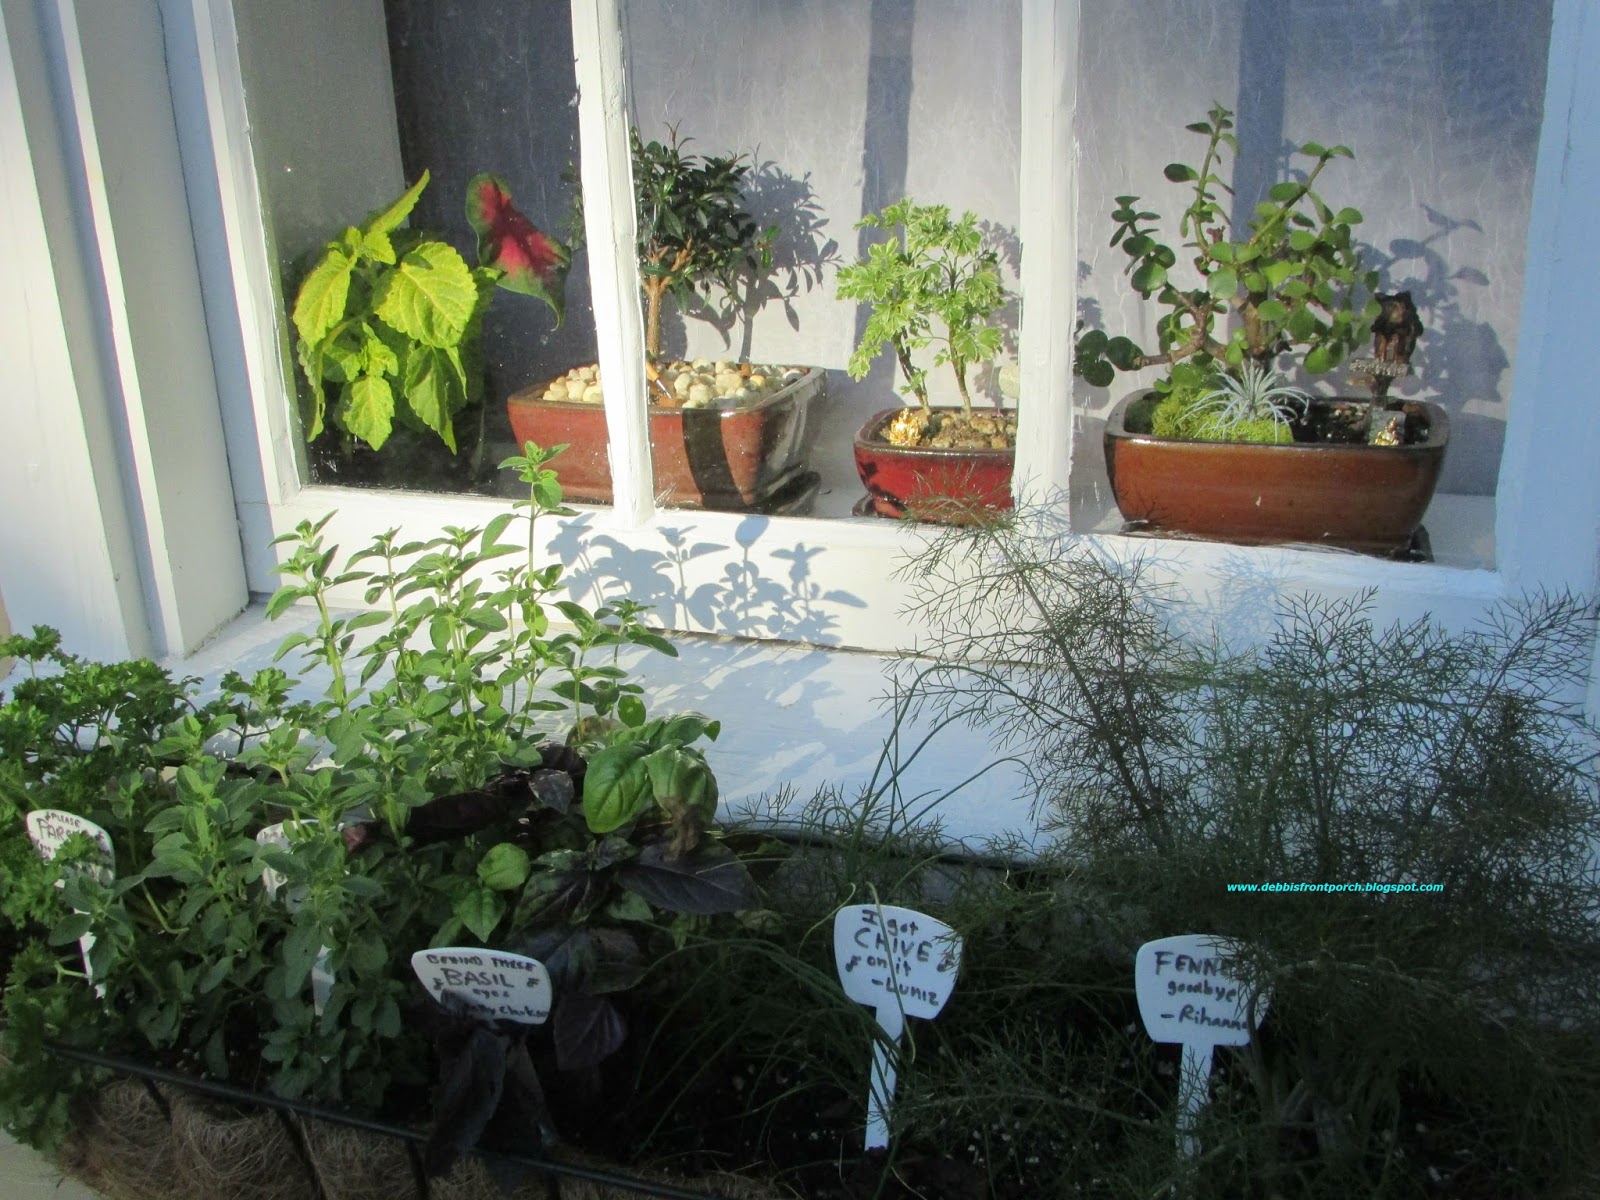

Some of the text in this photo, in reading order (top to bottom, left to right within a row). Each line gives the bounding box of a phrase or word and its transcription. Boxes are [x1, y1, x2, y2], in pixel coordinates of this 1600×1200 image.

[886, 918, 919, 937] got
[853, 926, 933, 963] CHIVE
[866, 955, 912, 977] on it
[440, 967, 515, 989] BASIL
[1167, 978, 1237, 1003] goodbye
